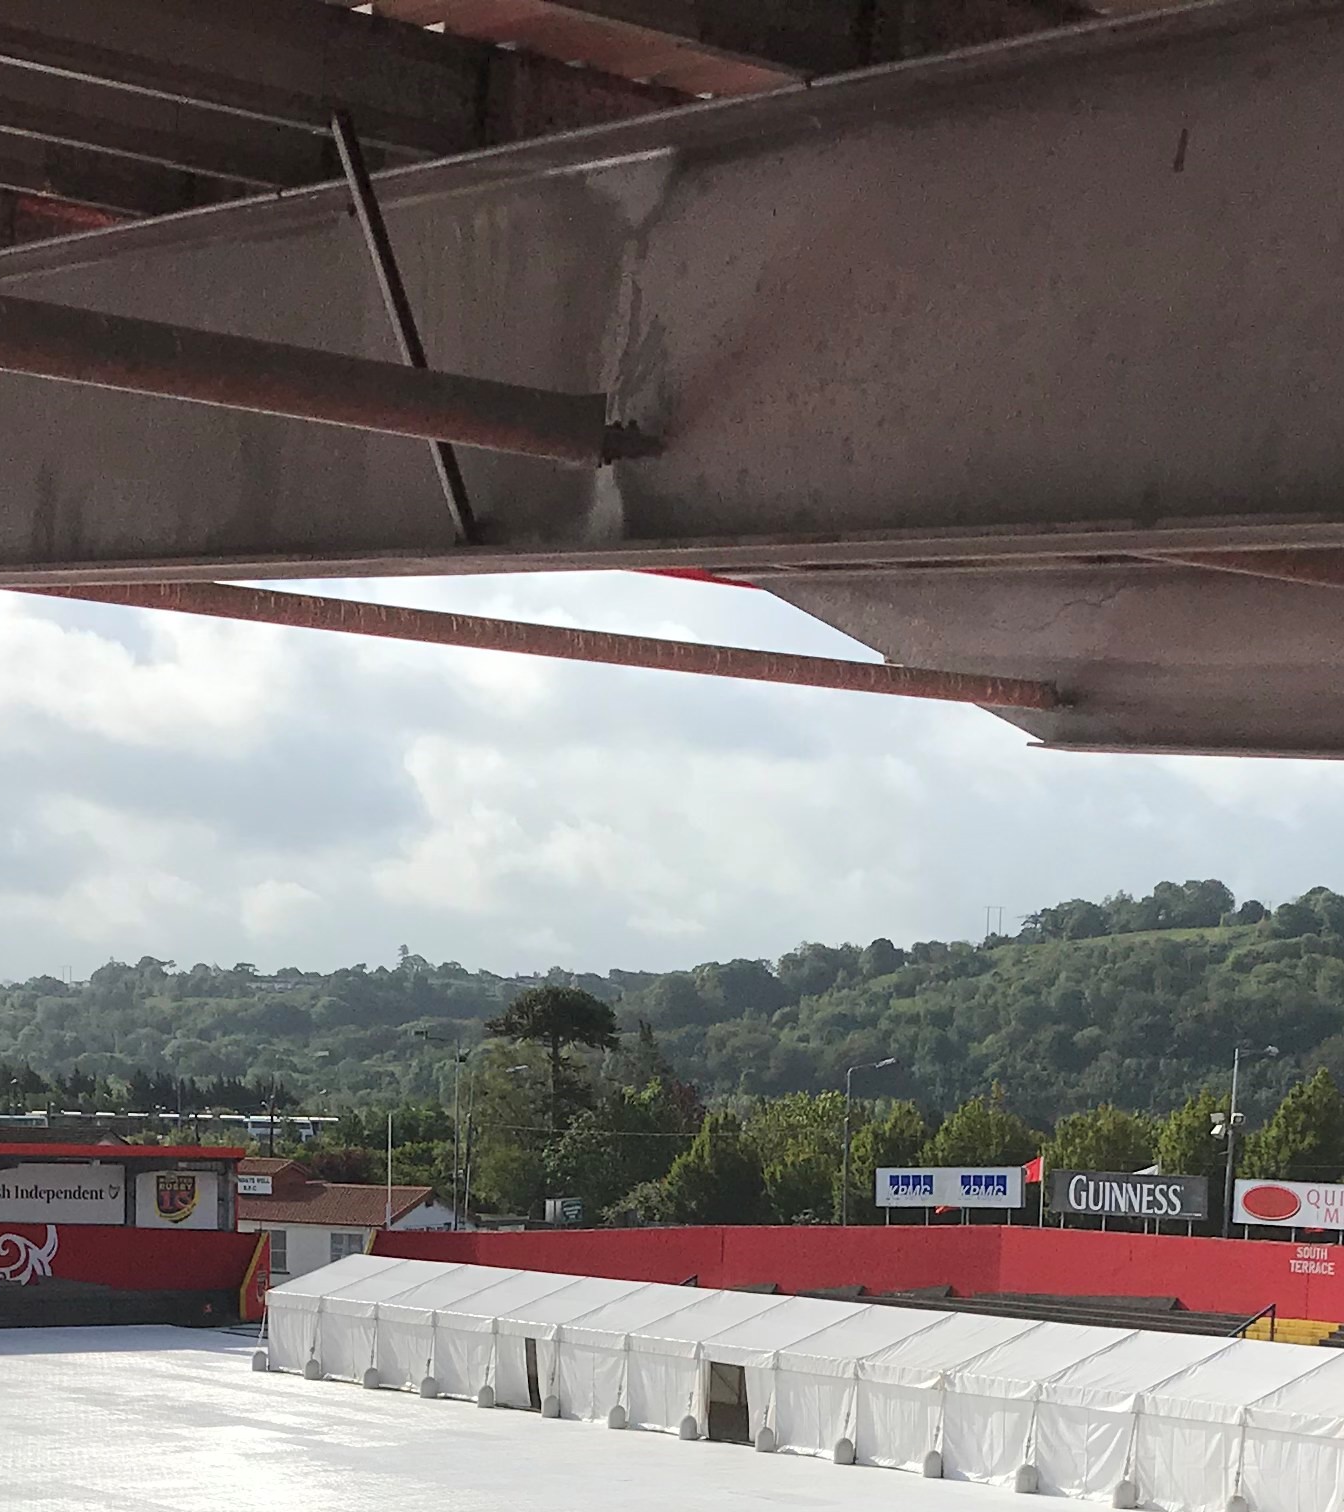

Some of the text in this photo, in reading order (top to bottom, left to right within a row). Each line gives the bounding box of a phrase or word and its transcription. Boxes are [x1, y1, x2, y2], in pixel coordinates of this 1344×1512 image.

[14, 1184, 104, 1204] Independent
[159, 1183, 192, 1191] RUGBY
[888, 1184, 932, 1198] KPMG
[960, 1184, 1004, 1198] KPMG
[1068, 1174, 1182, 1215] GUINNESS
[1296, 1246, 1328, 1260] SOUTH
[1289, 1260, 1335, 1276] TERRACE
